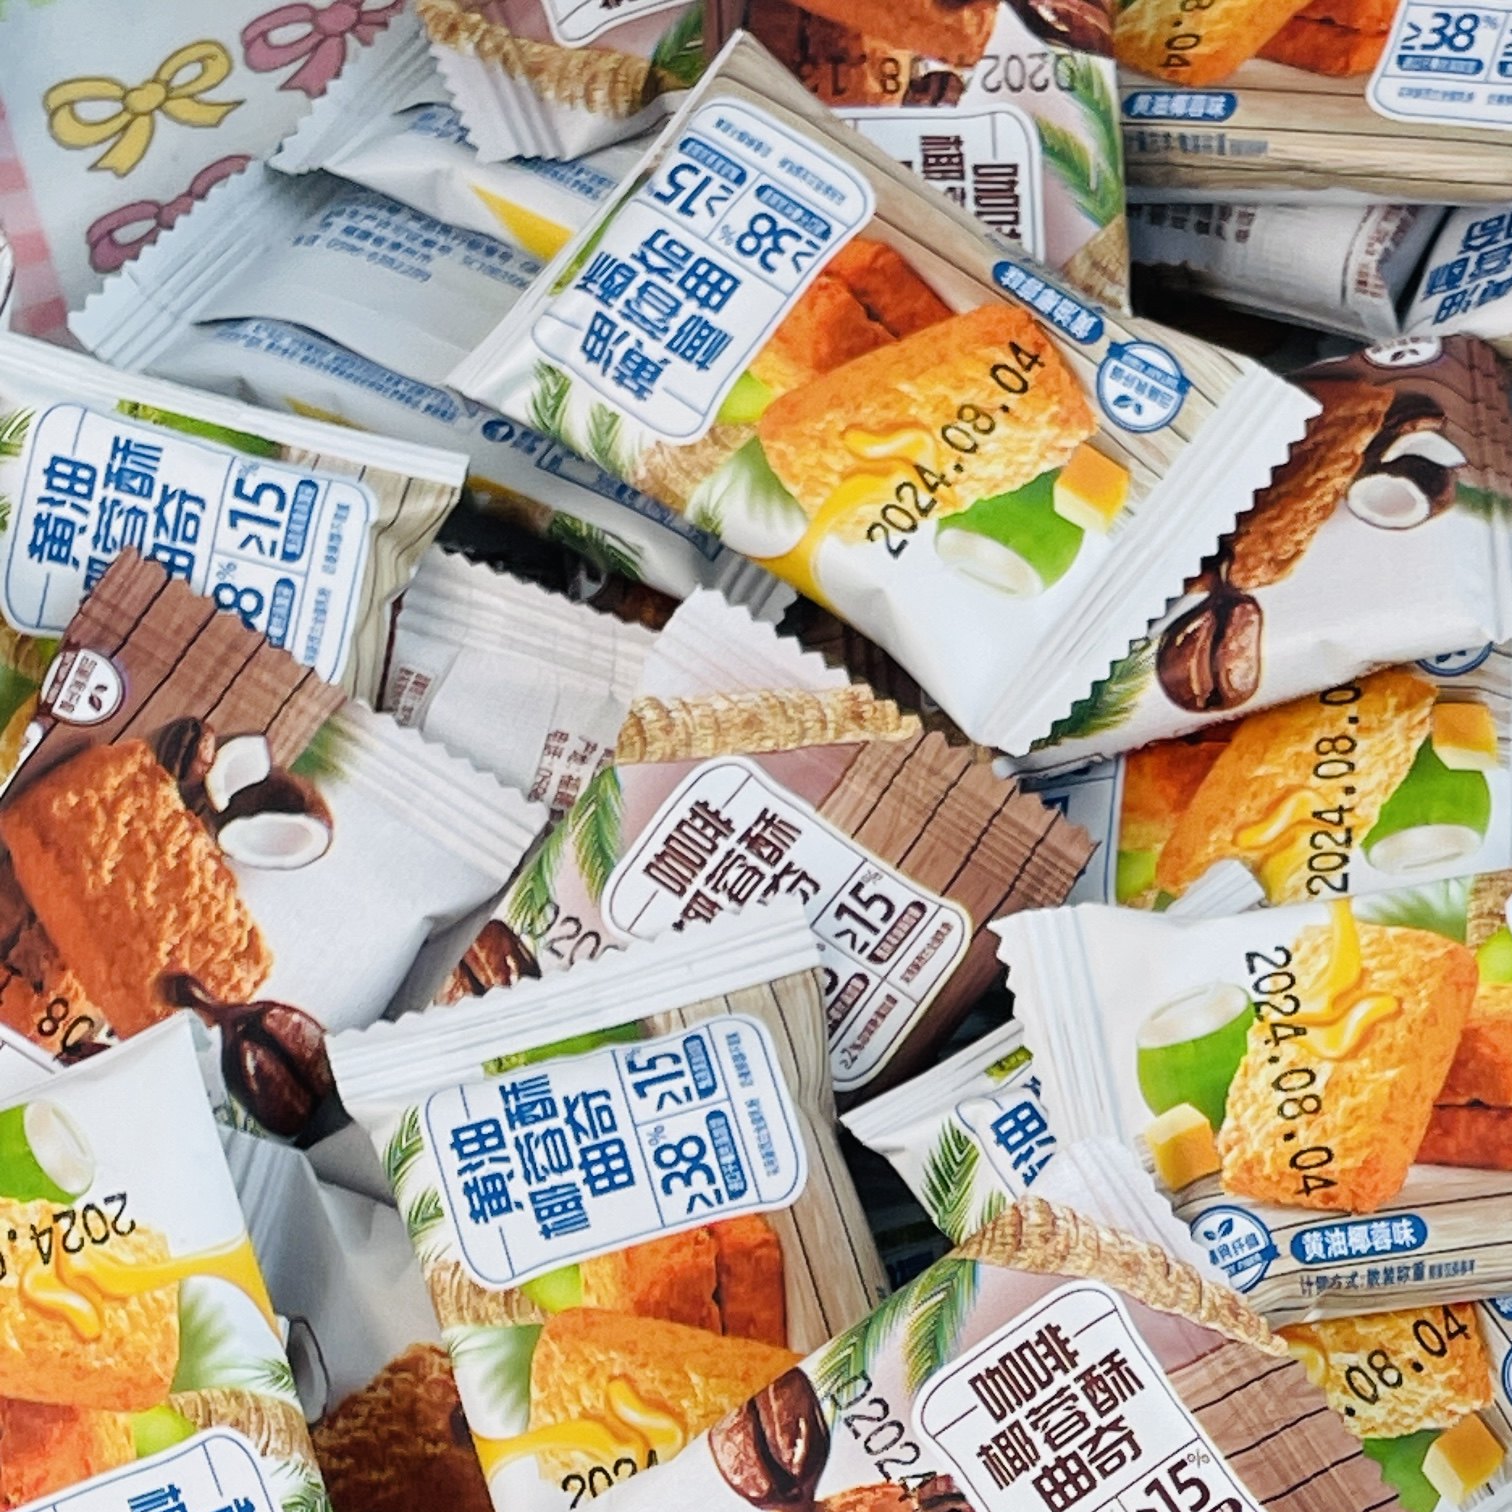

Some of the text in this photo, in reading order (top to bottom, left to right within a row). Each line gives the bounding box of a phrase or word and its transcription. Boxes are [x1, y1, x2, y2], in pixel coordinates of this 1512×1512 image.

[631, 229, 742, 313] 曲奇
[721, 213, 821, 273] ≥38%
[574, 251, 733, 371] 椰蓉酥
[581, 310, 671, 400] 黄油
[867, 342, 1045, 559] 2024.08.04
[28, 455, 98, 572] 黄油
[229, 462, 287, 558] ≥15%
[643, 799, 736, 898] 咖啡
[1245, 946, 1337, 1197] 2024.08.04
[450, 1118, 523, 1224] 黄油
[500, 1074, 591, 1240] 椰蓉酥
[564, 1089, 635, 1197] 曲奇
[646, 1125, 722, 1215] ≥38%
[0, 1192, 136, 1280] 2024.
[1301, 1220, 1417, 1261] 黄油椰蓉味
[968, 1323, 1079, 1423] 咖啡
[976, 1348, 1145, 1490] 椰蓉酥
